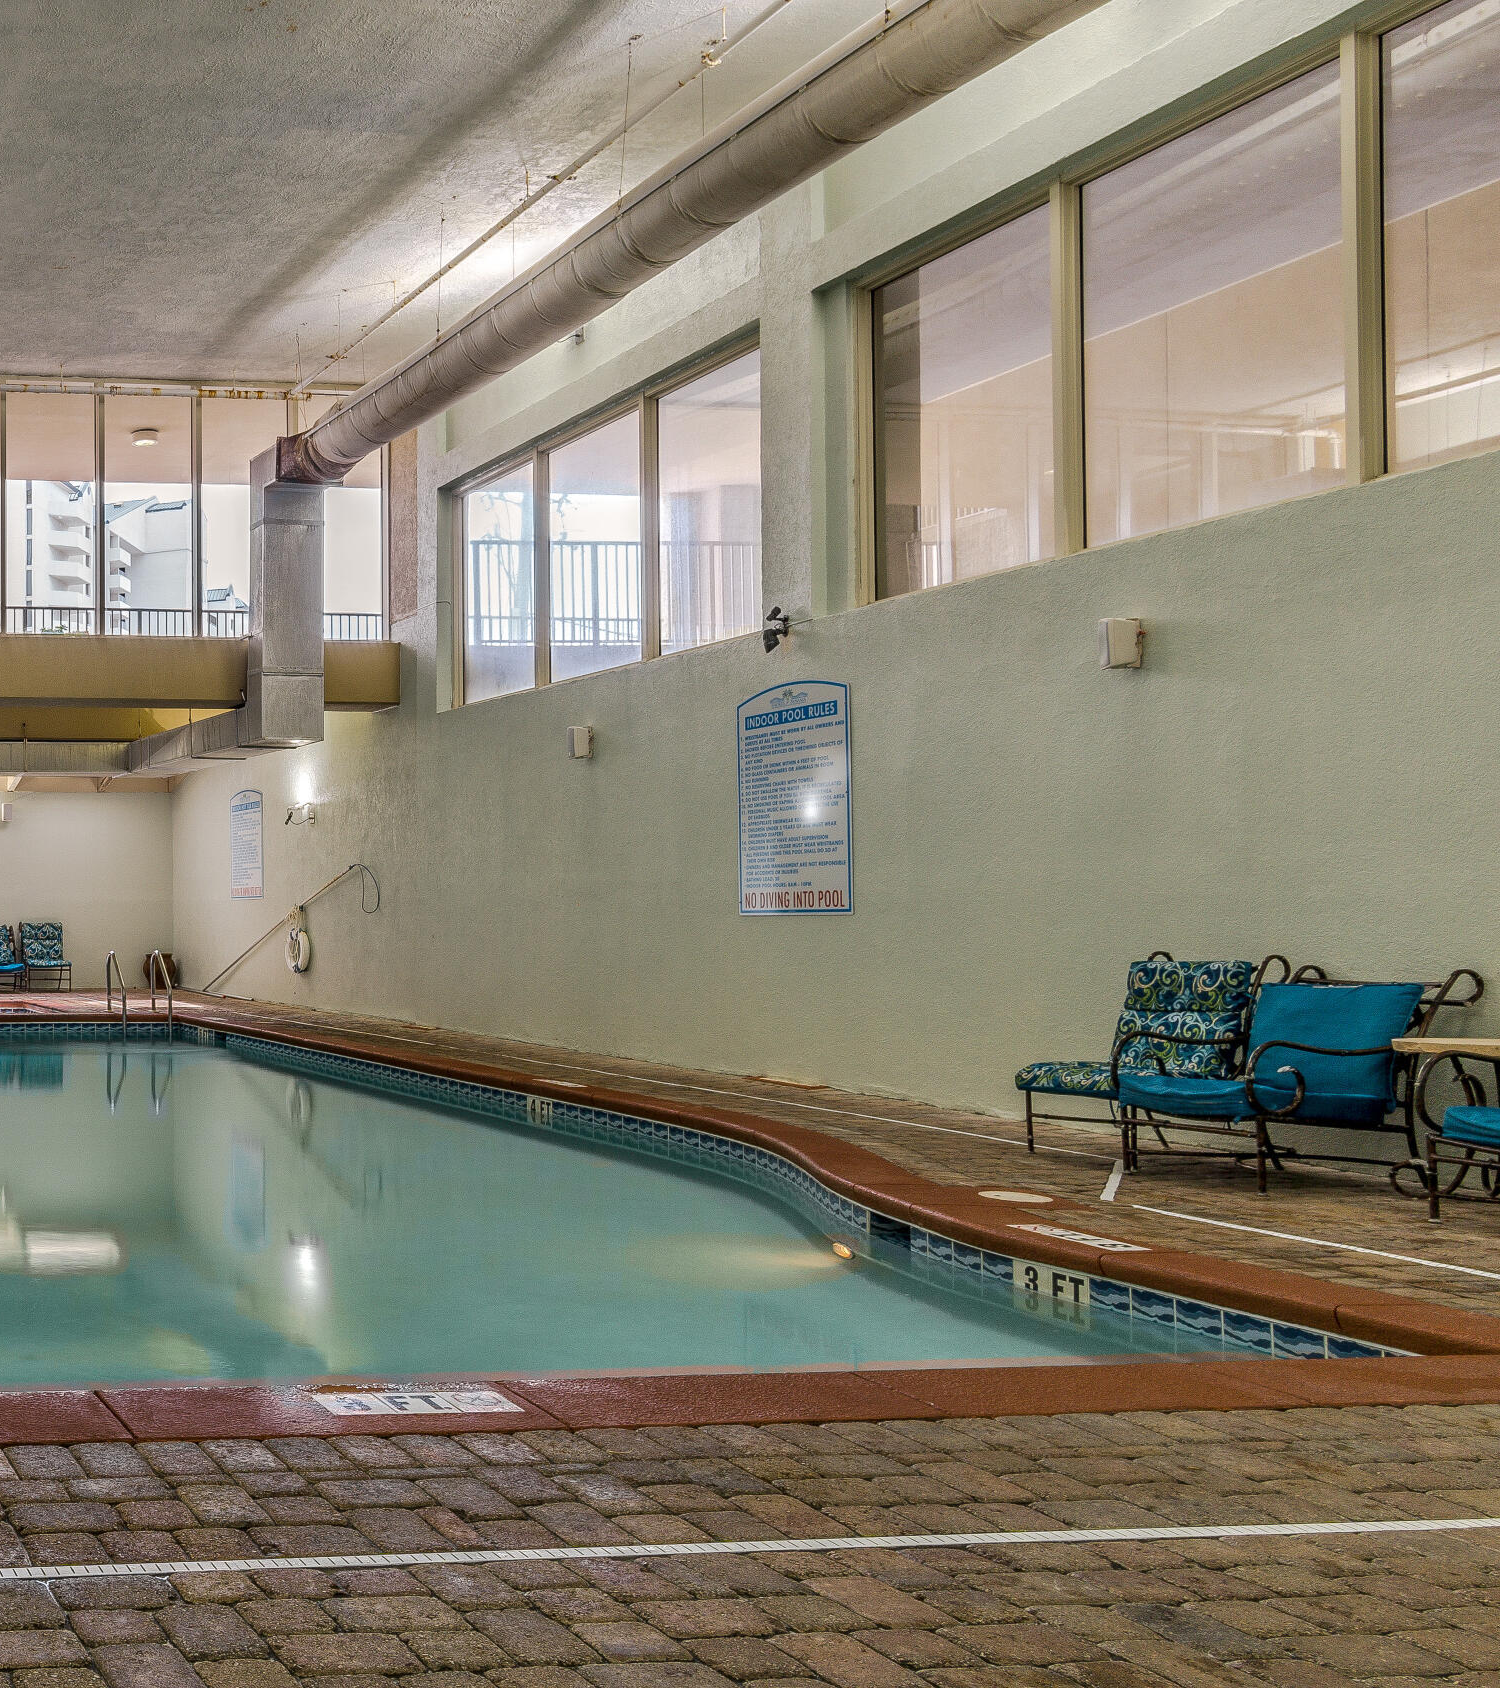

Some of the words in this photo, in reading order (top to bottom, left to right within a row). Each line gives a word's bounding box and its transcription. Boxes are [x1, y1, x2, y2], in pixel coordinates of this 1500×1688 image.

[747, 713, 779, 728] INDOOR
[783, 708, 805, 722] POOL
[809, 703, 835, 717] RULES
[745, 892, 756, 908] NO
[760, 891, 790, 908] DIVING
[793, 891, 815, 908] INTO
[818, 890, 844, 908] POOL
[530, 1099, 536, 1111] 4
[1024, 1266, 1038, 1291] 3
[1052, 1272, 1085, 1303] FT
